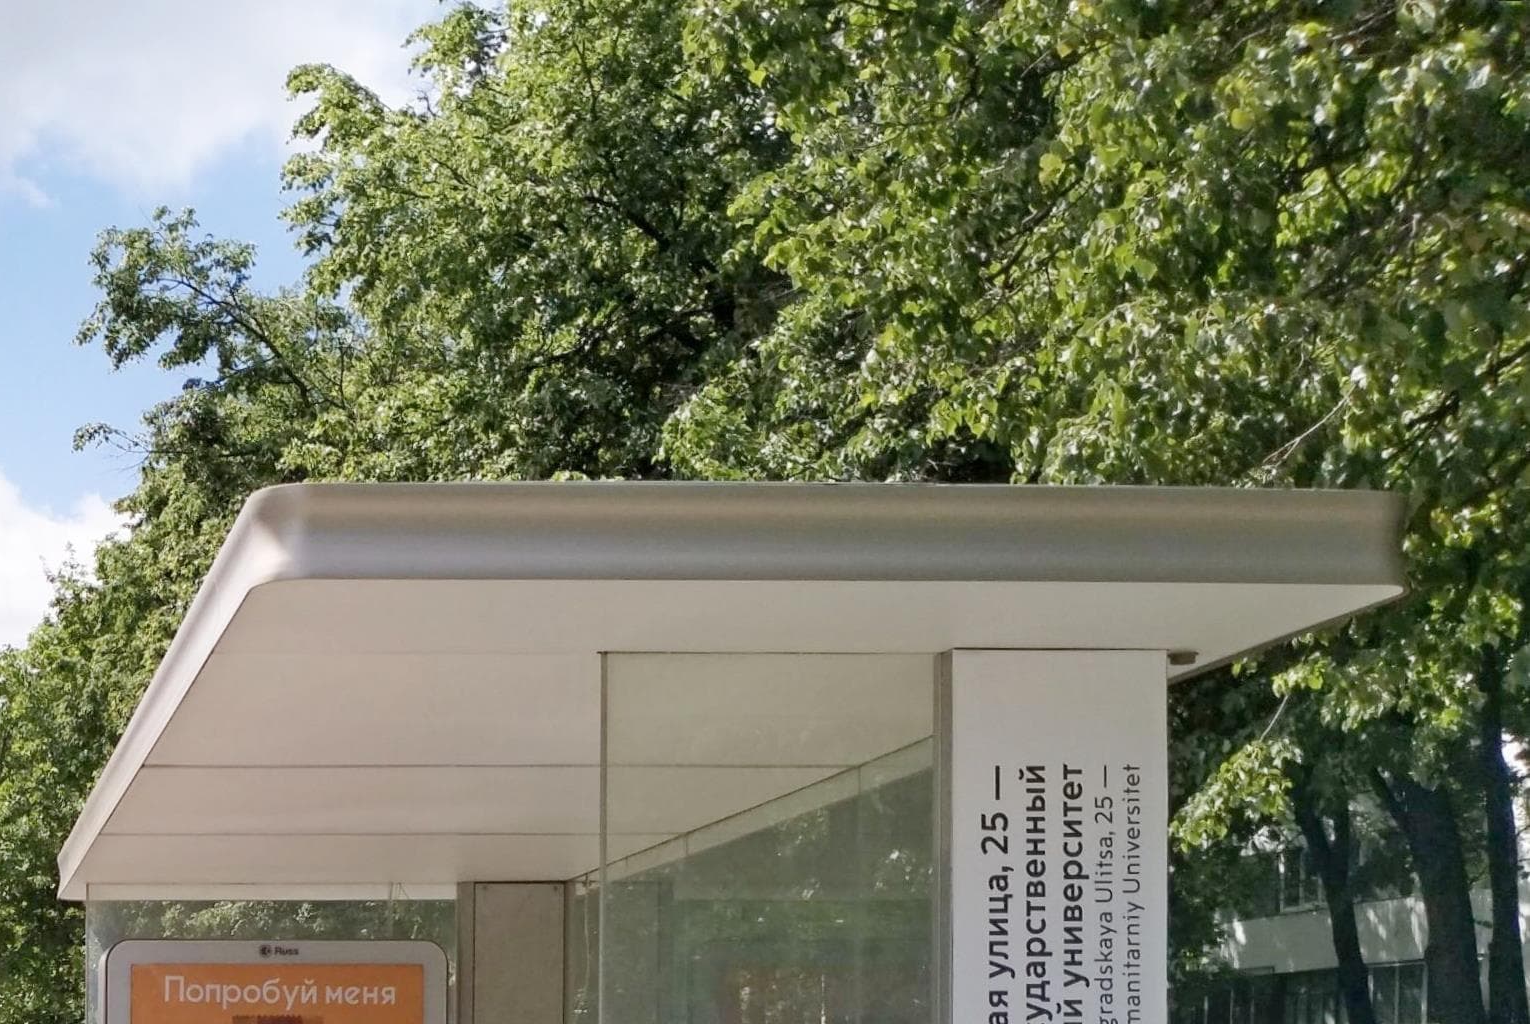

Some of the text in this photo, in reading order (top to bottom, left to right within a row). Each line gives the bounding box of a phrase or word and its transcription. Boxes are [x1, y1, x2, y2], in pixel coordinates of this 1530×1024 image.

[980, 812, 1009, 855] 25
[1094, 796, 1114, 824] 25
[1121, 763, 1141, 894] Universitet
[1062, 763, 1090, 989] университет
[1093, 831, 1116, 903] Ulitsa,
[988, 865, 1015, 980] улица,
[164, 975, 397, 1011] Попробуй меня
